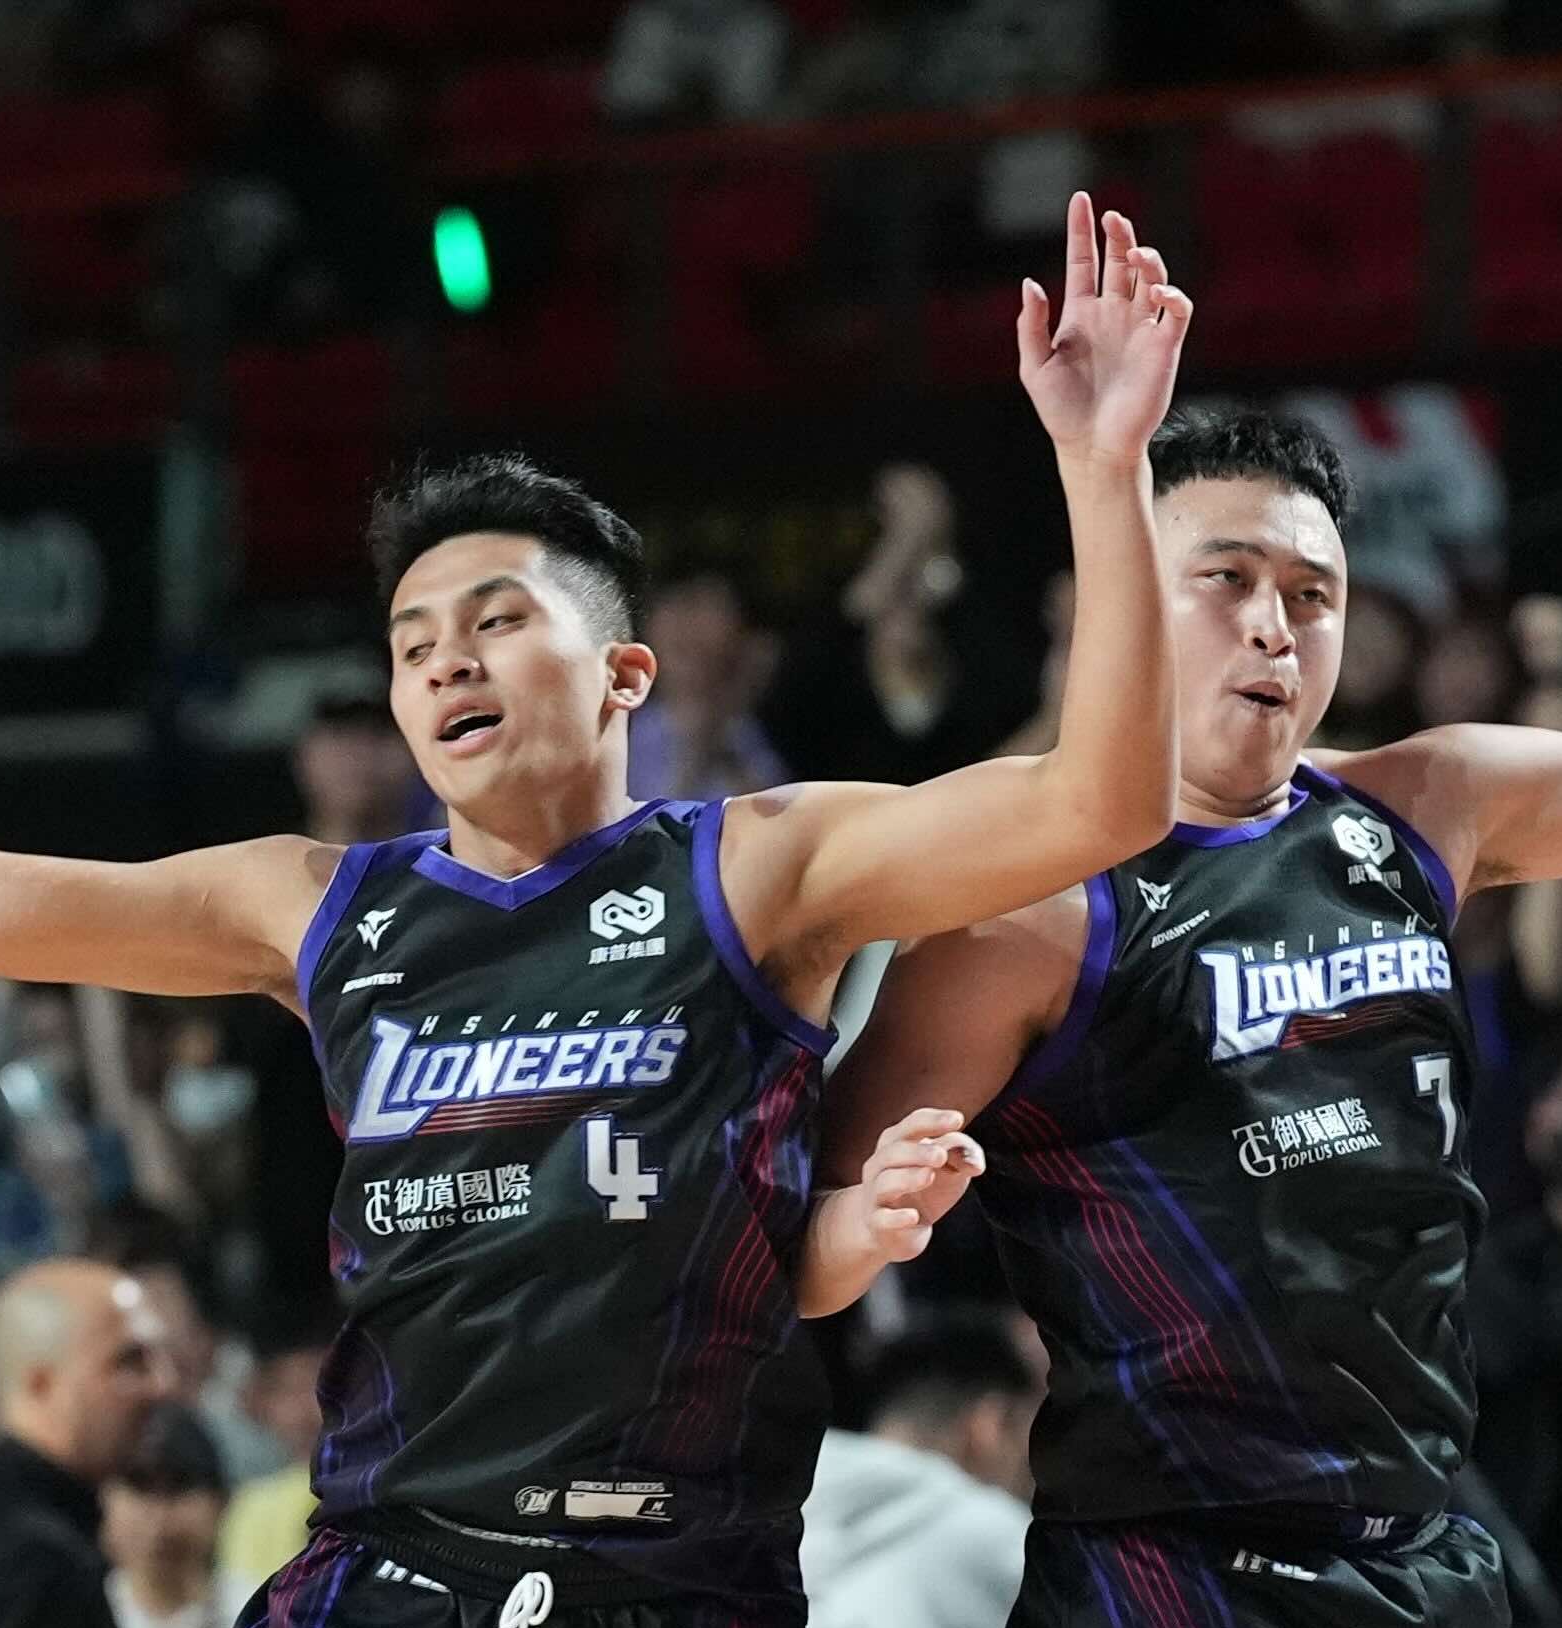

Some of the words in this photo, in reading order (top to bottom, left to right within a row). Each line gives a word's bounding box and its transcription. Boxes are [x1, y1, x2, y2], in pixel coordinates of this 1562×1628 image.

[1242, 914, 1436, 962] HSINCH
[418, 1006, 684, 1036] HSINCHU
[1197, 938, 1452, 1063] LIONEERS
[346, 1014, 690, 1142] LIONEERS
[1413, 1053, 1457, 1158] 7
[584, 1116, 660, 1221] 4
[1281, 1143, 1333, 1170] TOPLUS
[1334, 1133, 1381, 1155] GLOBAL
[394, 1213, 456, 1233] TOPLUS
[462, 1202, 530, 1224] GLOBAL
